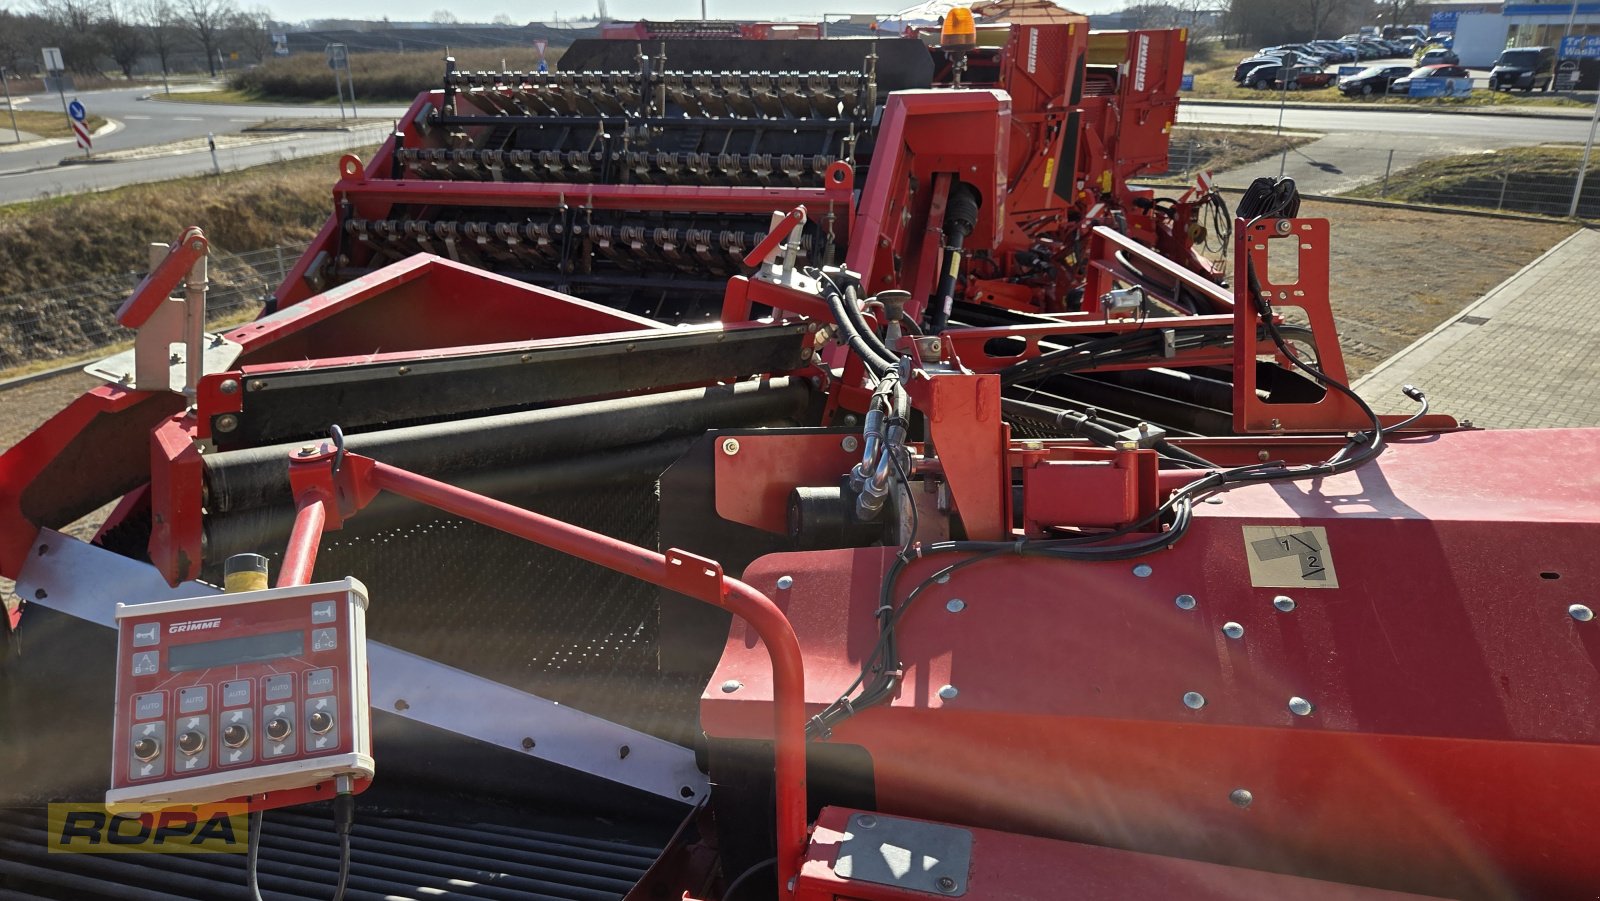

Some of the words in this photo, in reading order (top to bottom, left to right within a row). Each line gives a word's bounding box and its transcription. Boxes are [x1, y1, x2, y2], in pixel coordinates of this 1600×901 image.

[1028, 27, 1039, 73] GRIMME
[1135, 34, 1149, 91] GRIMME
[1282, 540, 1290, 551] 1
[1308, 556, 1320, 568] 2
[168, 617, 222, 634] GRIMME
[312, 678, 331, 686] AUTO
[271, 684, 289, 692] AUTO
[228, 690, 247, 698] AUTO
[185, 696, 204, 704] AUTO
[141, 702, 160, 711] AUTO
